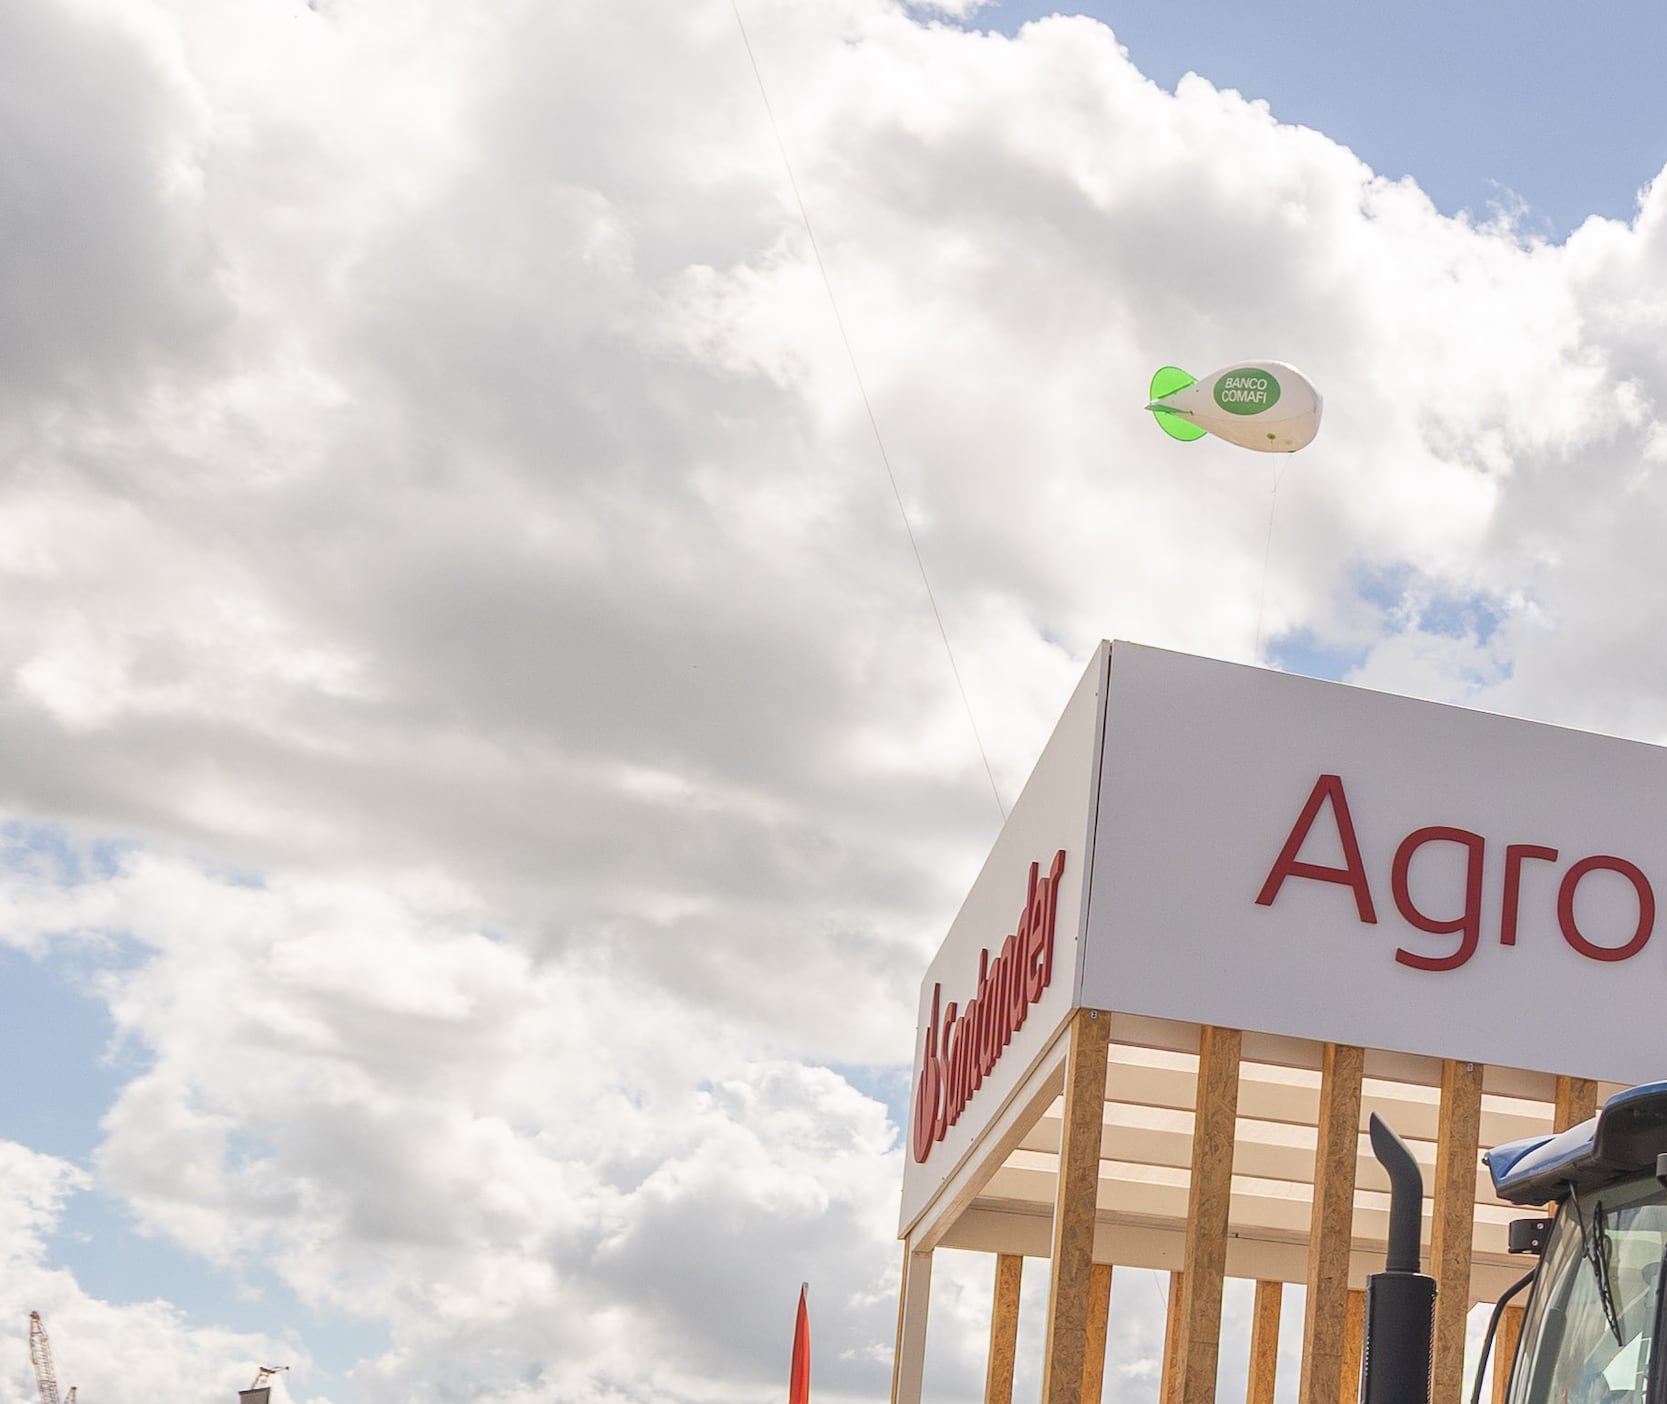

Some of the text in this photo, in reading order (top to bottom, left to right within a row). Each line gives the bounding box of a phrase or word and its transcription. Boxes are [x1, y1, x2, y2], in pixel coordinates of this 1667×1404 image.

[1224, 377, 1268, 391] BANCO
[1221, 389, 1268, 404] COMAFI
[934, 849, 1066, 1142] Santander
